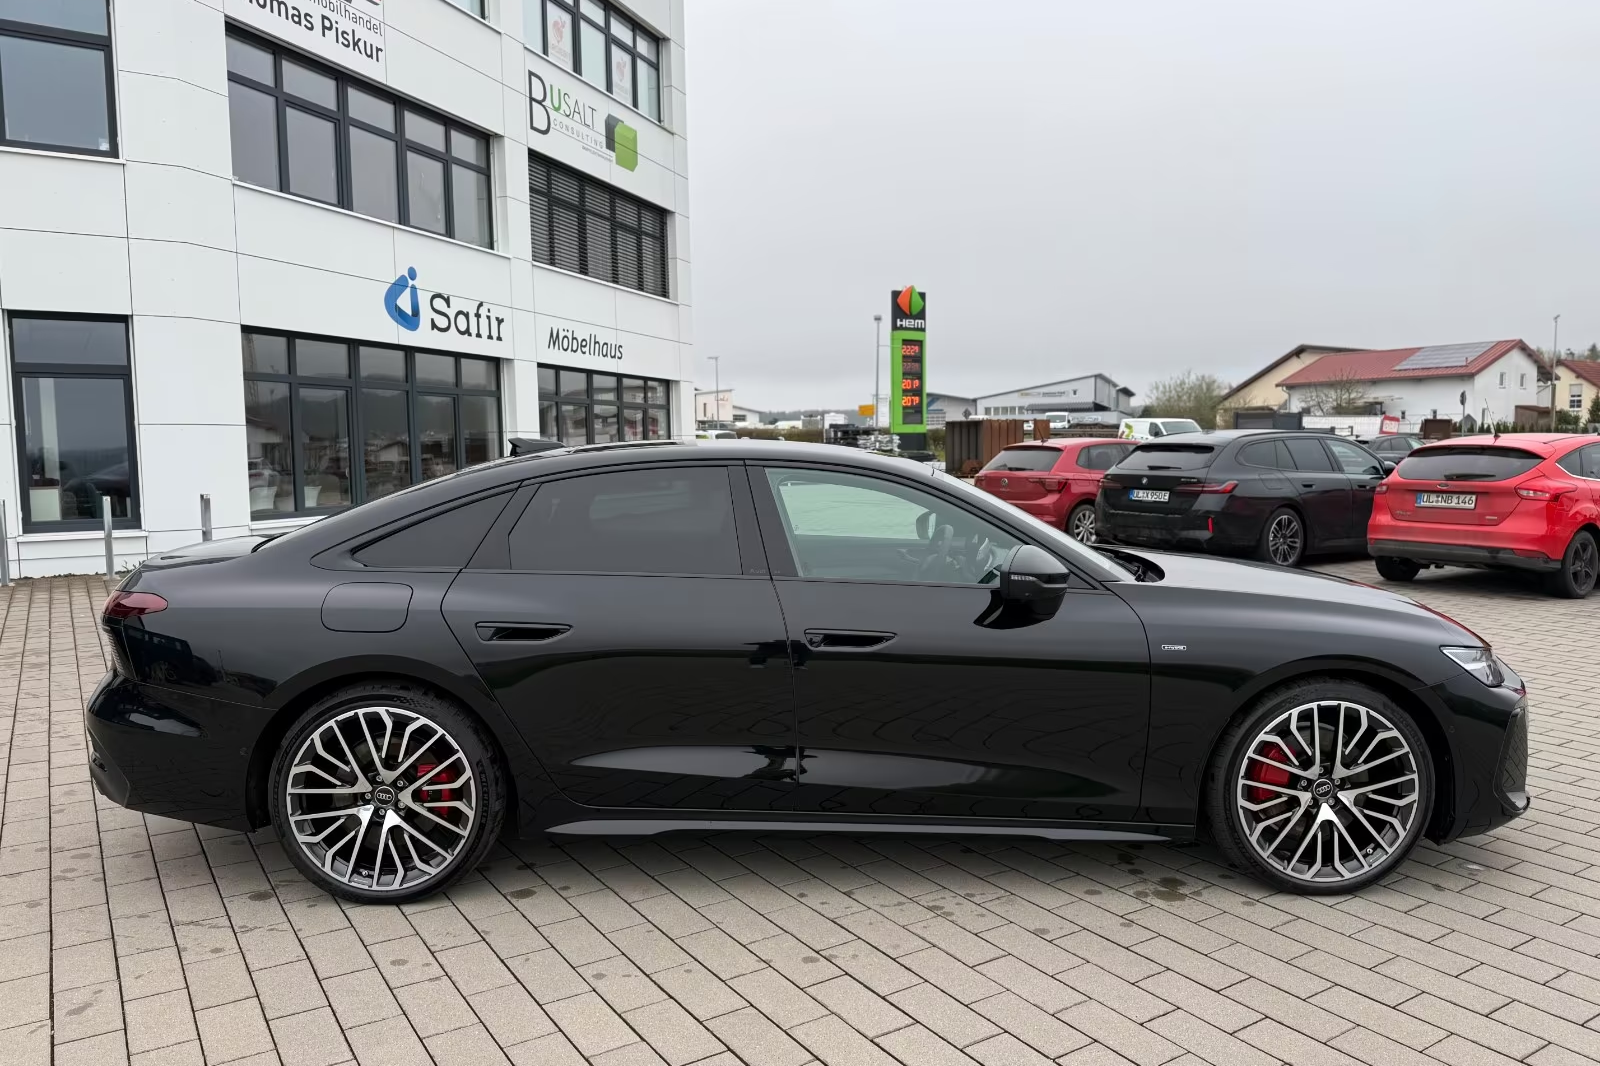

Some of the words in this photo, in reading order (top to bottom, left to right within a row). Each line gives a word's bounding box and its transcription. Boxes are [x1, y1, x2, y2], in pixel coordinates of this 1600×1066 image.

[249, 0, 314, 31] omas
[321, 13, 383, 63] Piskur
[528, 69, 597, 136] BUSALT
[553, 118, 604, 149] CONSULTING
[429, 293, 505, 342] Safir
[548, 326, 623, 360] Möbelhaus
[1422, 494, 1434, 504] UL
[1440, 494, 1453, 504] NB
[1454, 495, 1474, 506] 146
